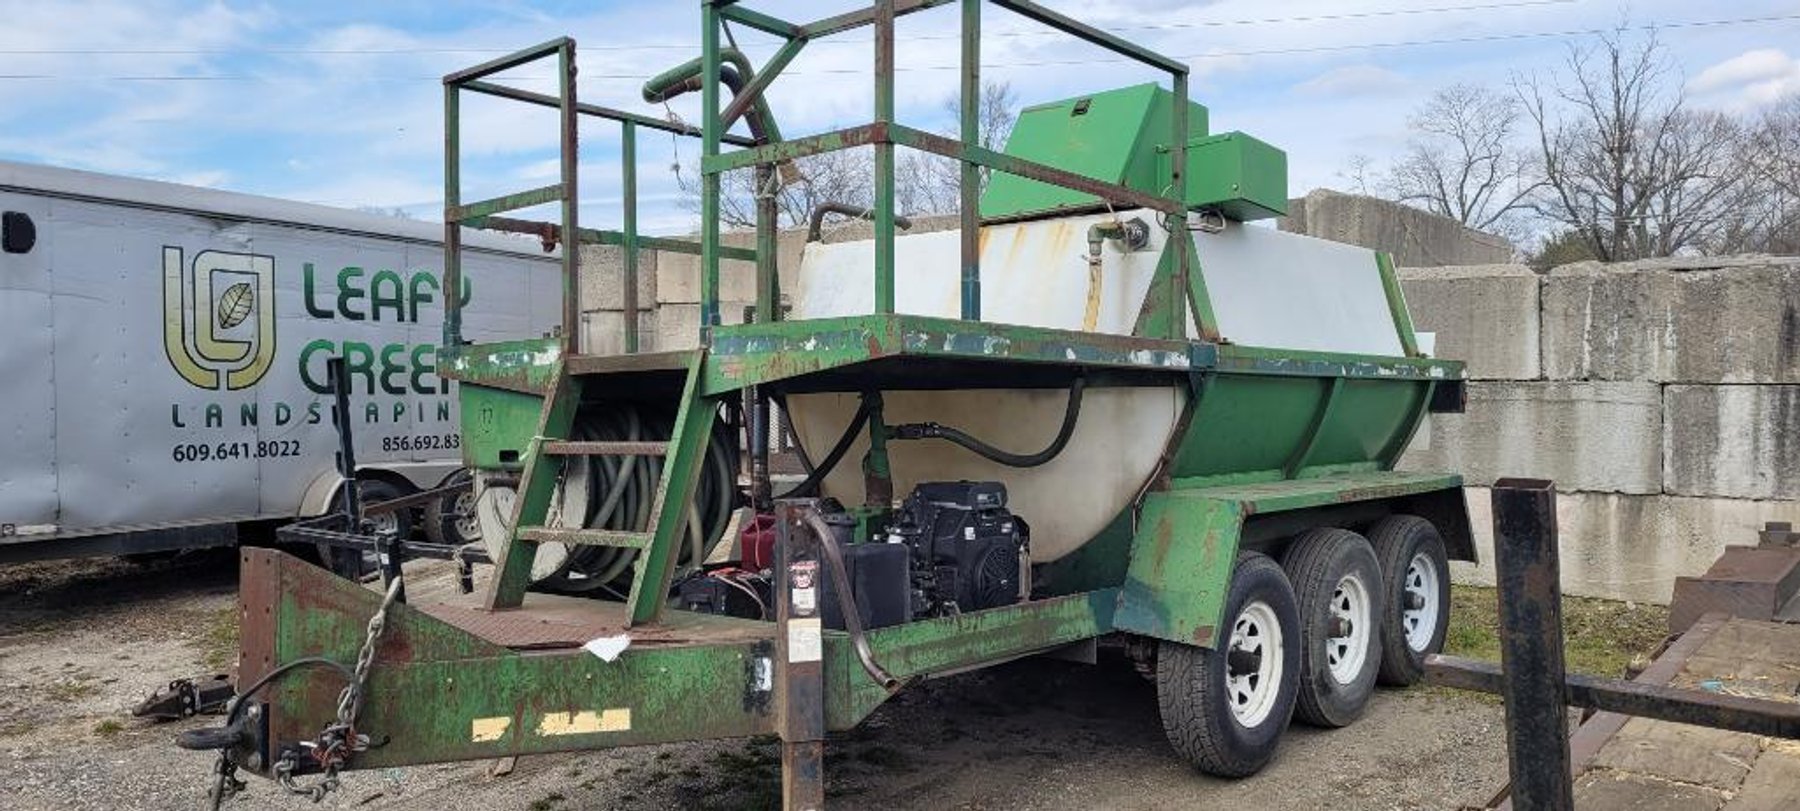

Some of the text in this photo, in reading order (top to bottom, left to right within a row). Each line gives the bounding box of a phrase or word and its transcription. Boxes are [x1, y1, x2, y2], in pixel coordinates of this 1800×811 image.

[299, 339, 448, 394] GREE
[172, 402, 449, 427] LANDSAPIN
[173, 434, 460, 462] 609.641.8022 856.692.83
